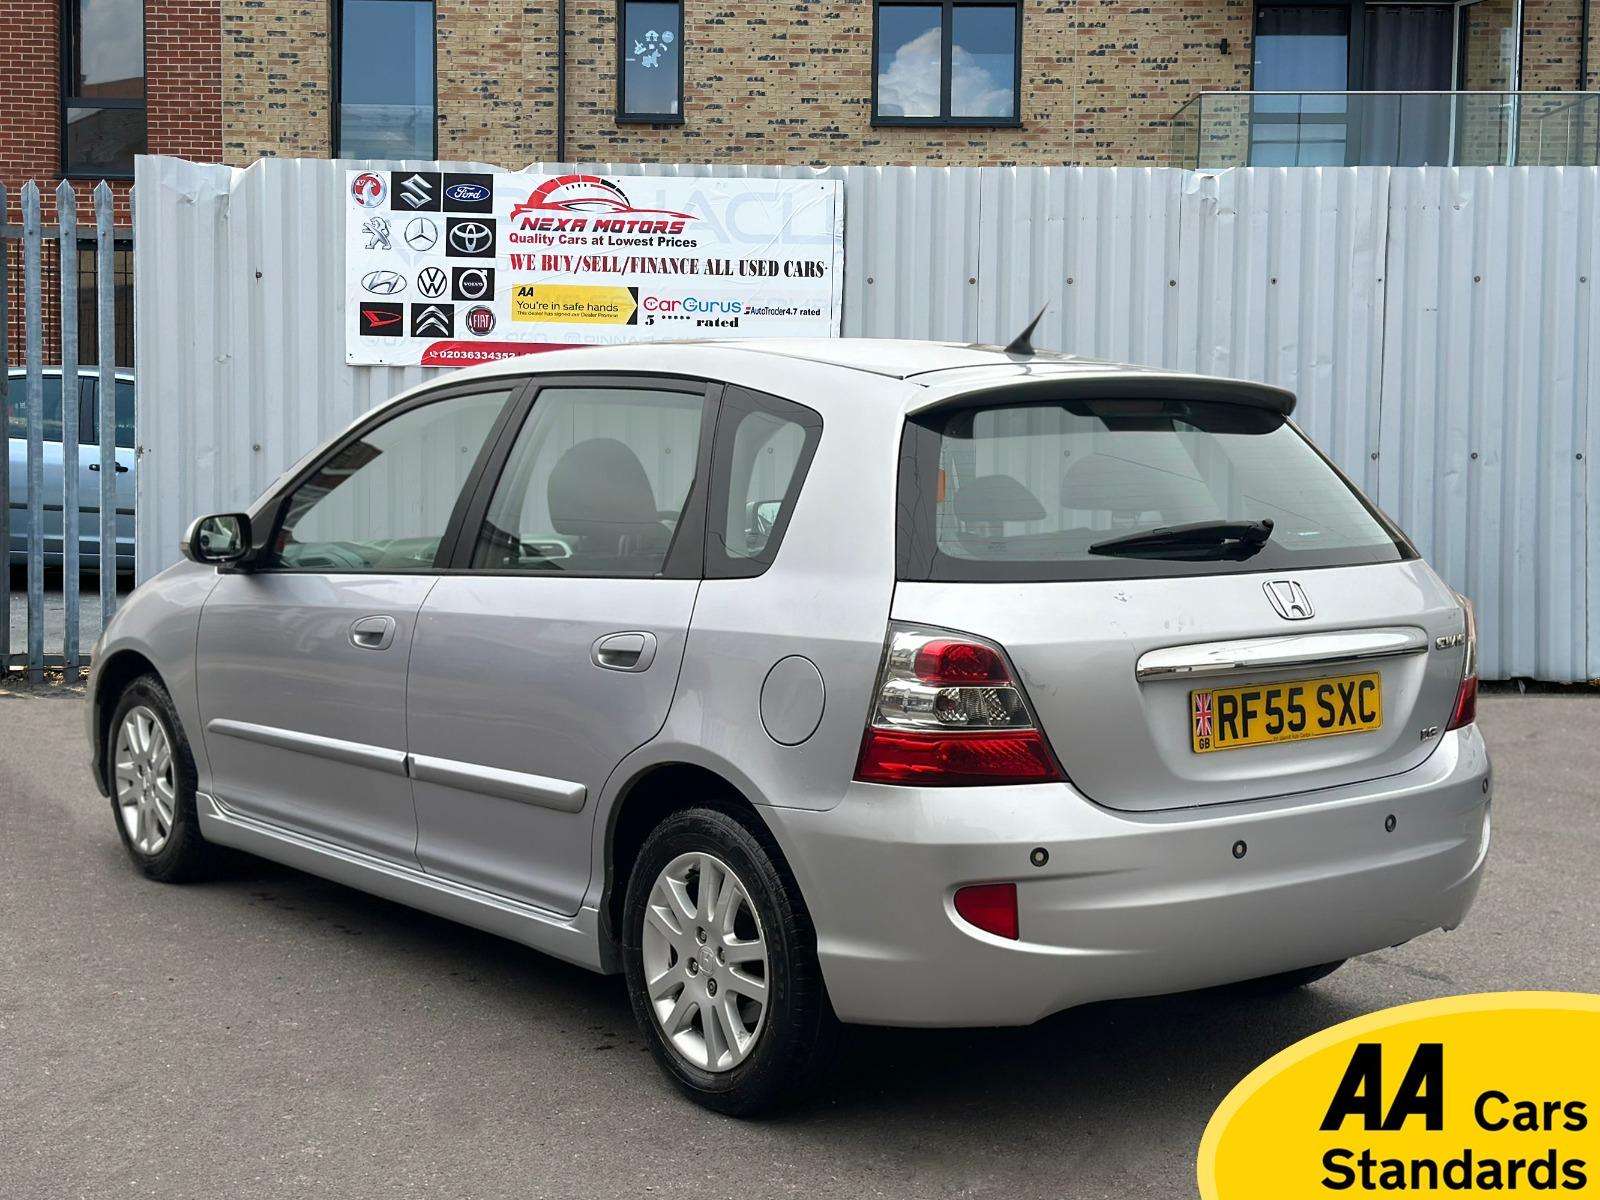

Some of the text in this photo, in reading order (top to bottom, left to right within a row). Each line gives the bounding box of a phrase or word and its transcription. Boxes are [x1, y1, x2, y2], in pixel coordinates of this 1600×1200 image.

[453, 186, 482, 199] Ford
[520, 217, 686, 234] NEXA MOTORS
[509, 232, 698, 248] Quality Cars at Lowest Prices
[509, 253, 536, 271] WE
[704, 258, 734, 276] ALL
[738, 258, 780, 277] USED
[517, 286, 534, 297] AA
[516, 300, 619, 312] You're in safe hands
[643, 296, 742, 313] CarGurus
[800, 308, 821, 316] rated
[472, 314, 491, 328] FIAT
[645, 314, 739, 328] 5 rated
[1218, 679, 1377, 742] RF55 SXC
[1199, 737, 1211, 749] GB
